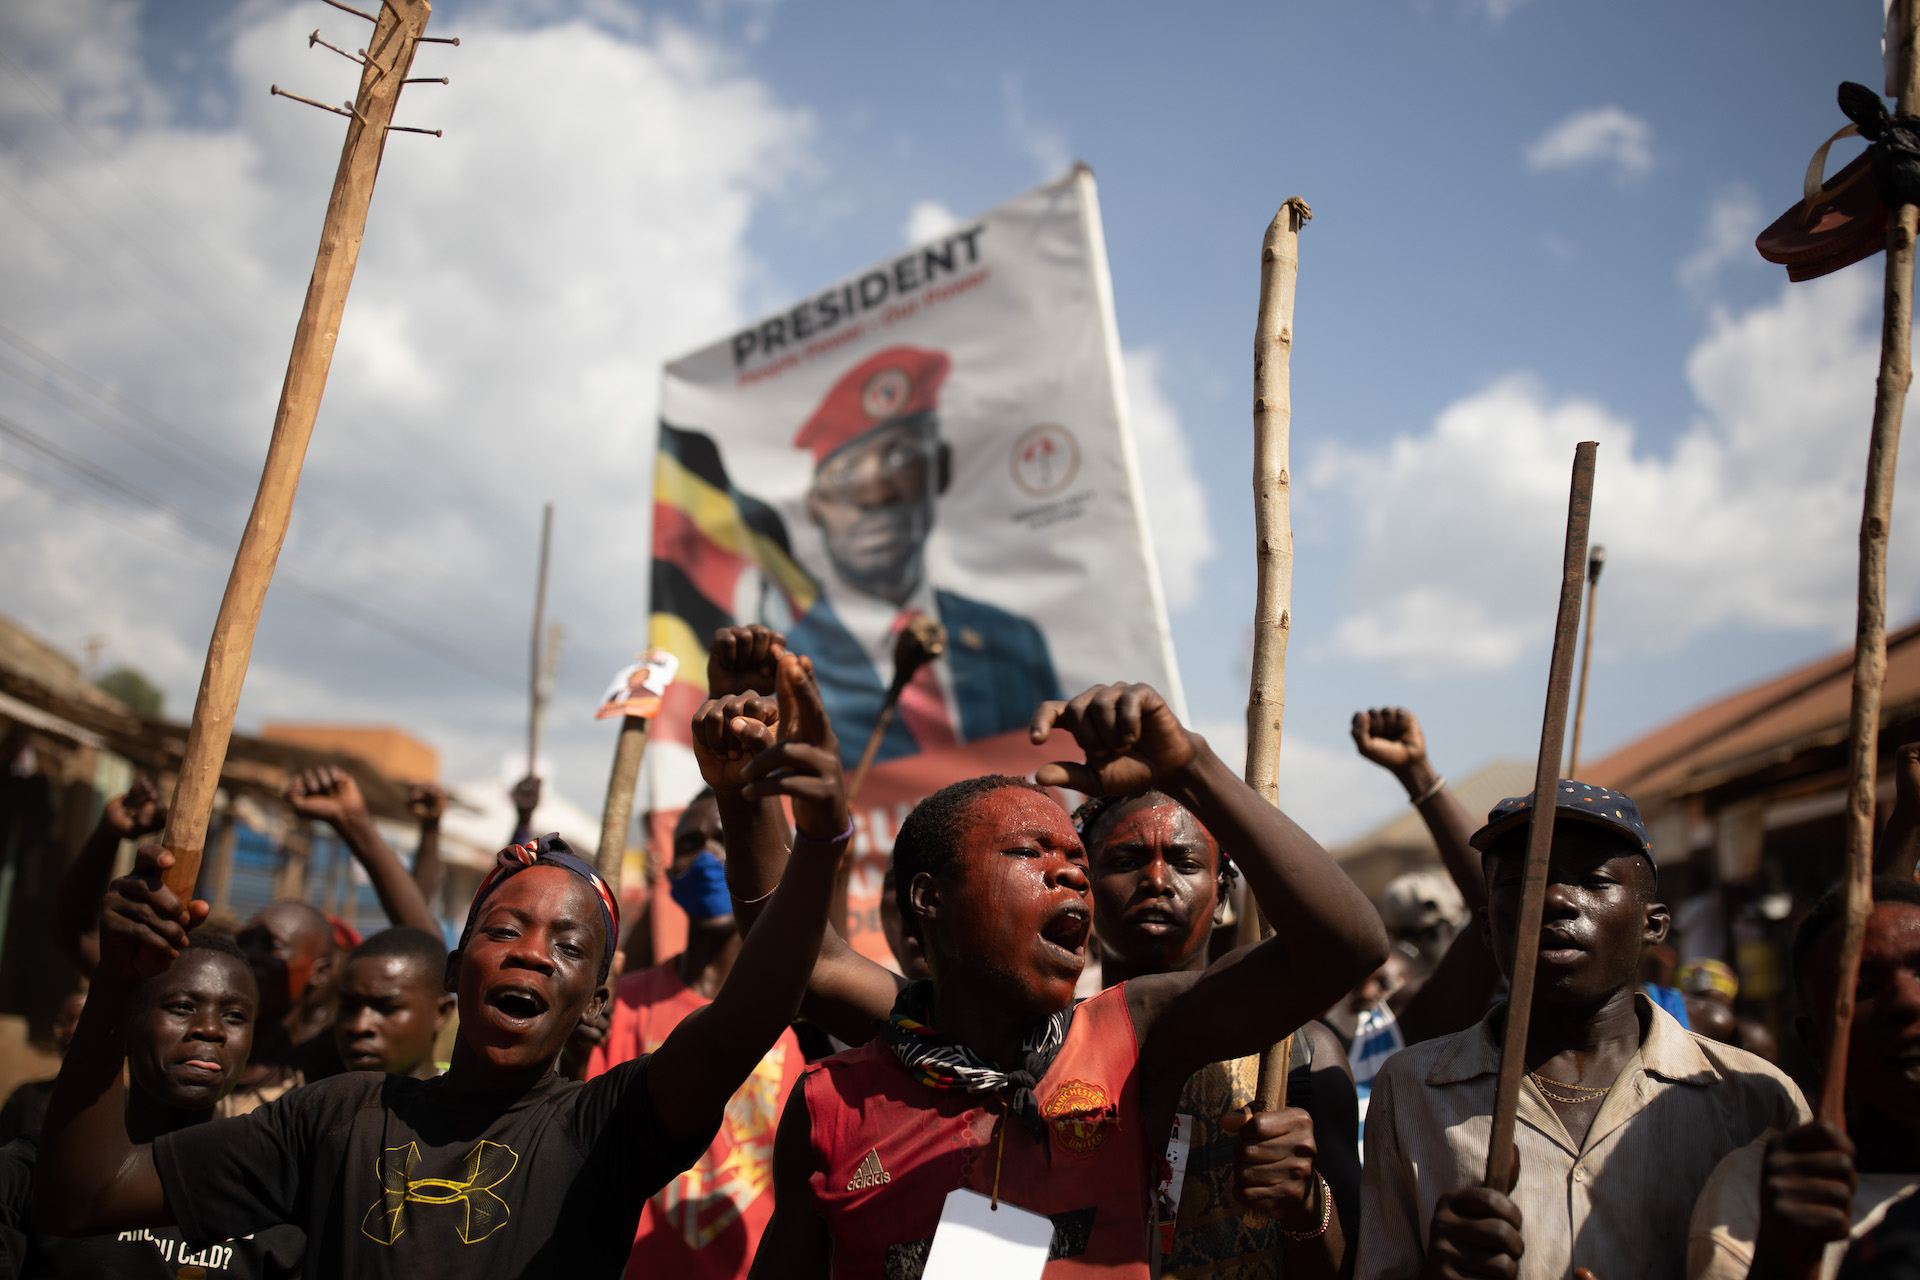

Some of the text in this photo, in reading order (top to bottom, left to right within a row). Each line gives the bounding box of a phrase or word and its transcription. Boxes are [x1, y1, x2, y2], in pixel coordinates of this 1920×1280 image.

[733, 226, 987, 366] PRESIDENT
[1052, 1088, 1102, 1113] MANCHESTER
[1069, 1133, 1103, 1148] UNITED
[846, 1171, 891, 1191] adidas
